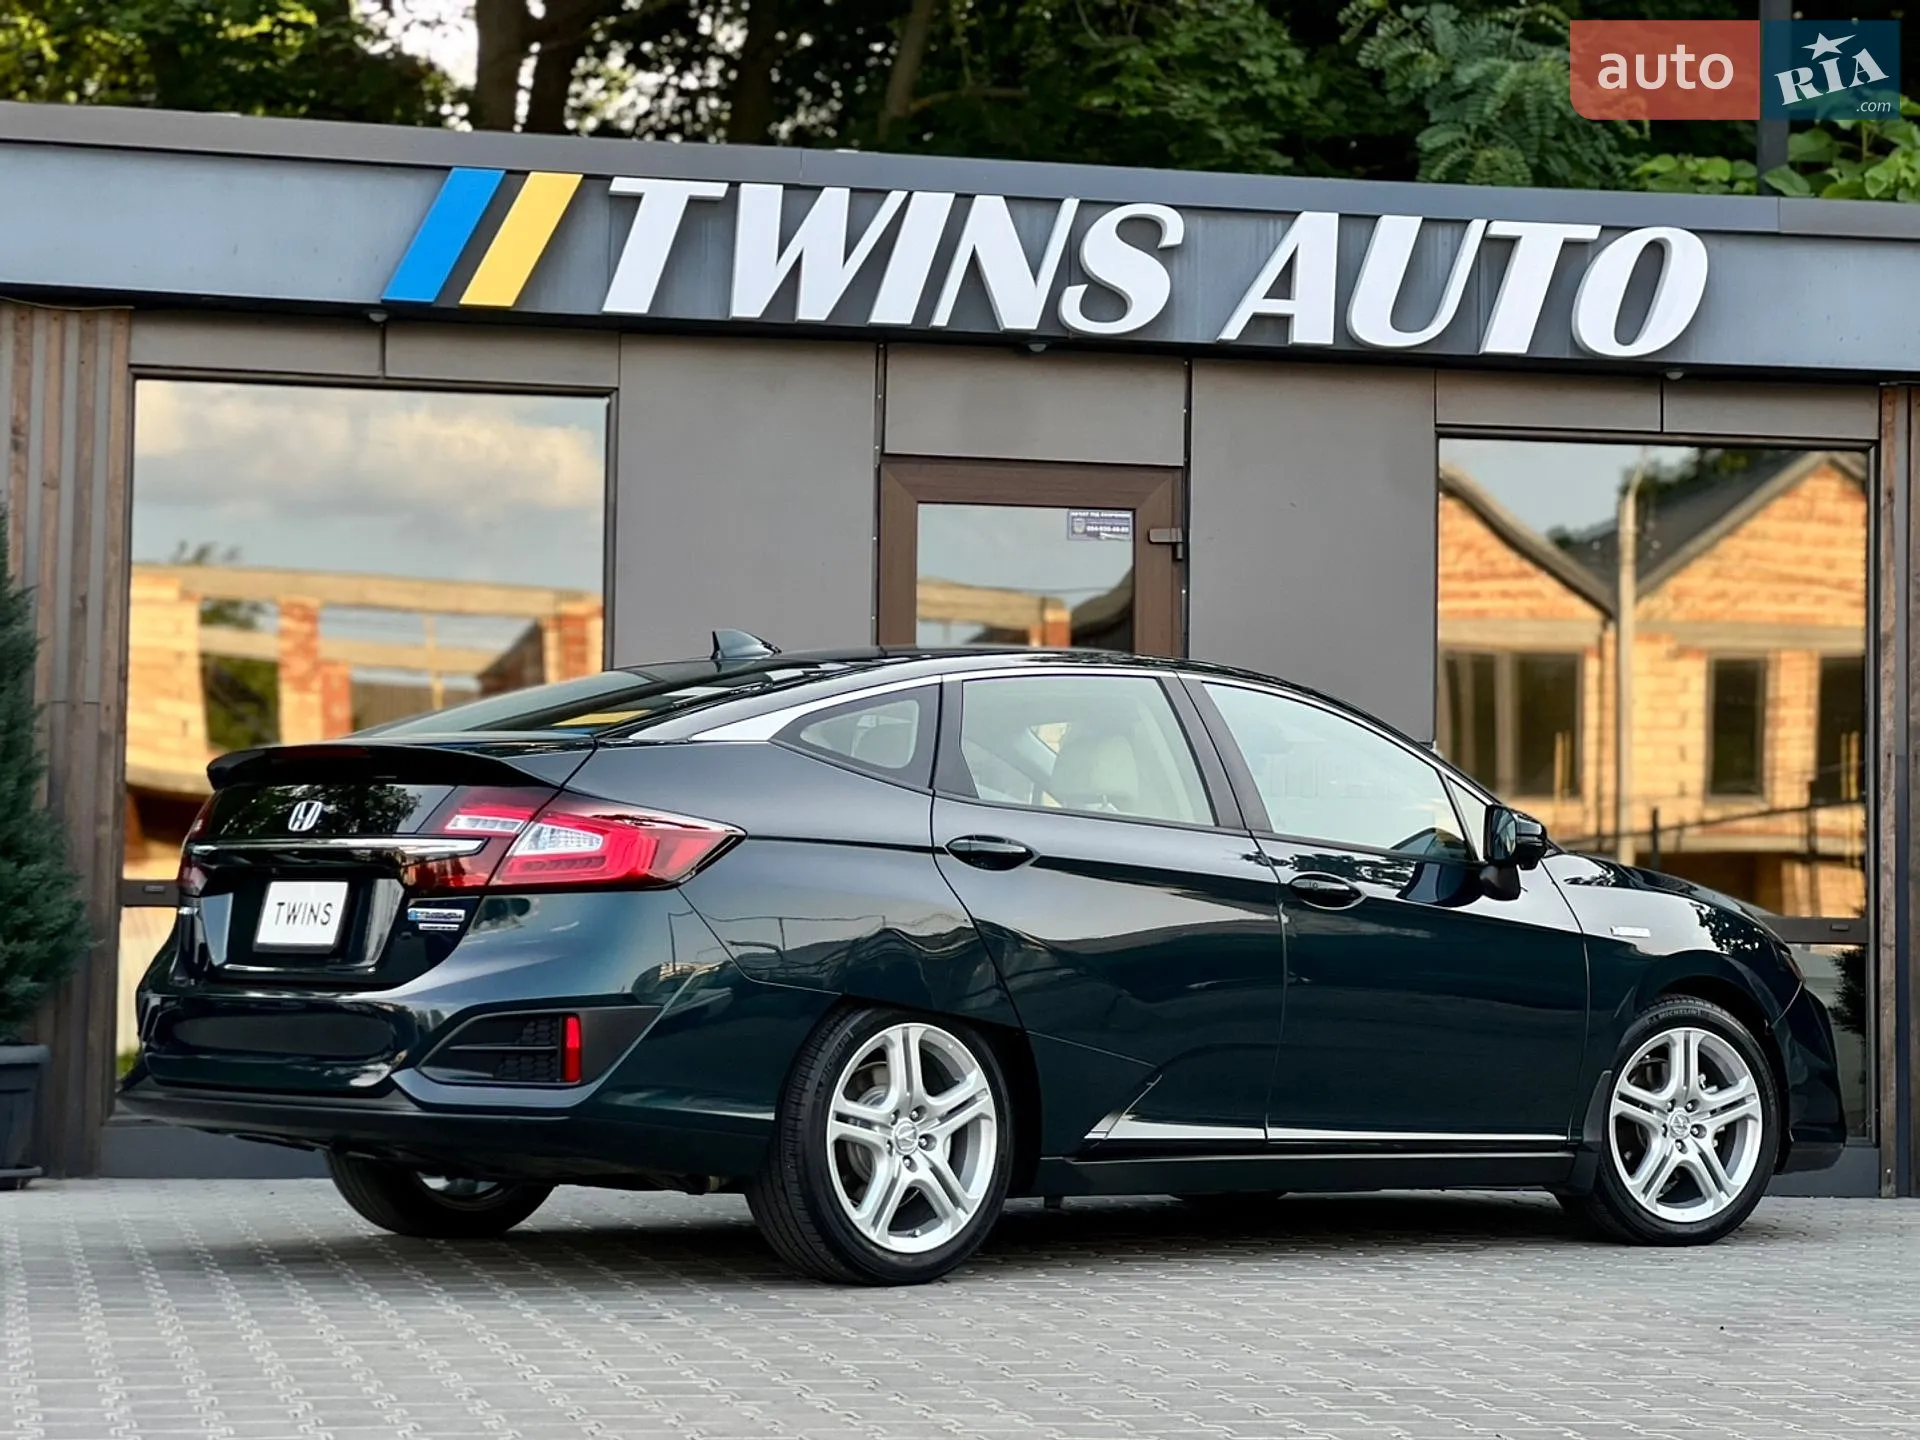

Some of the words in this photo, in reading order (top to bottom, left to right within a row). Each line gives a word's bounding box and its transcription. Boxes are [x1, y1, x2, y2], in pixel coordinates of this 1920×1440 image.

[601, 175, 1184, 336] TWINS
[1216, 210, 1709, 358] AUTO
[275, 902, 333, 926] TWINS
